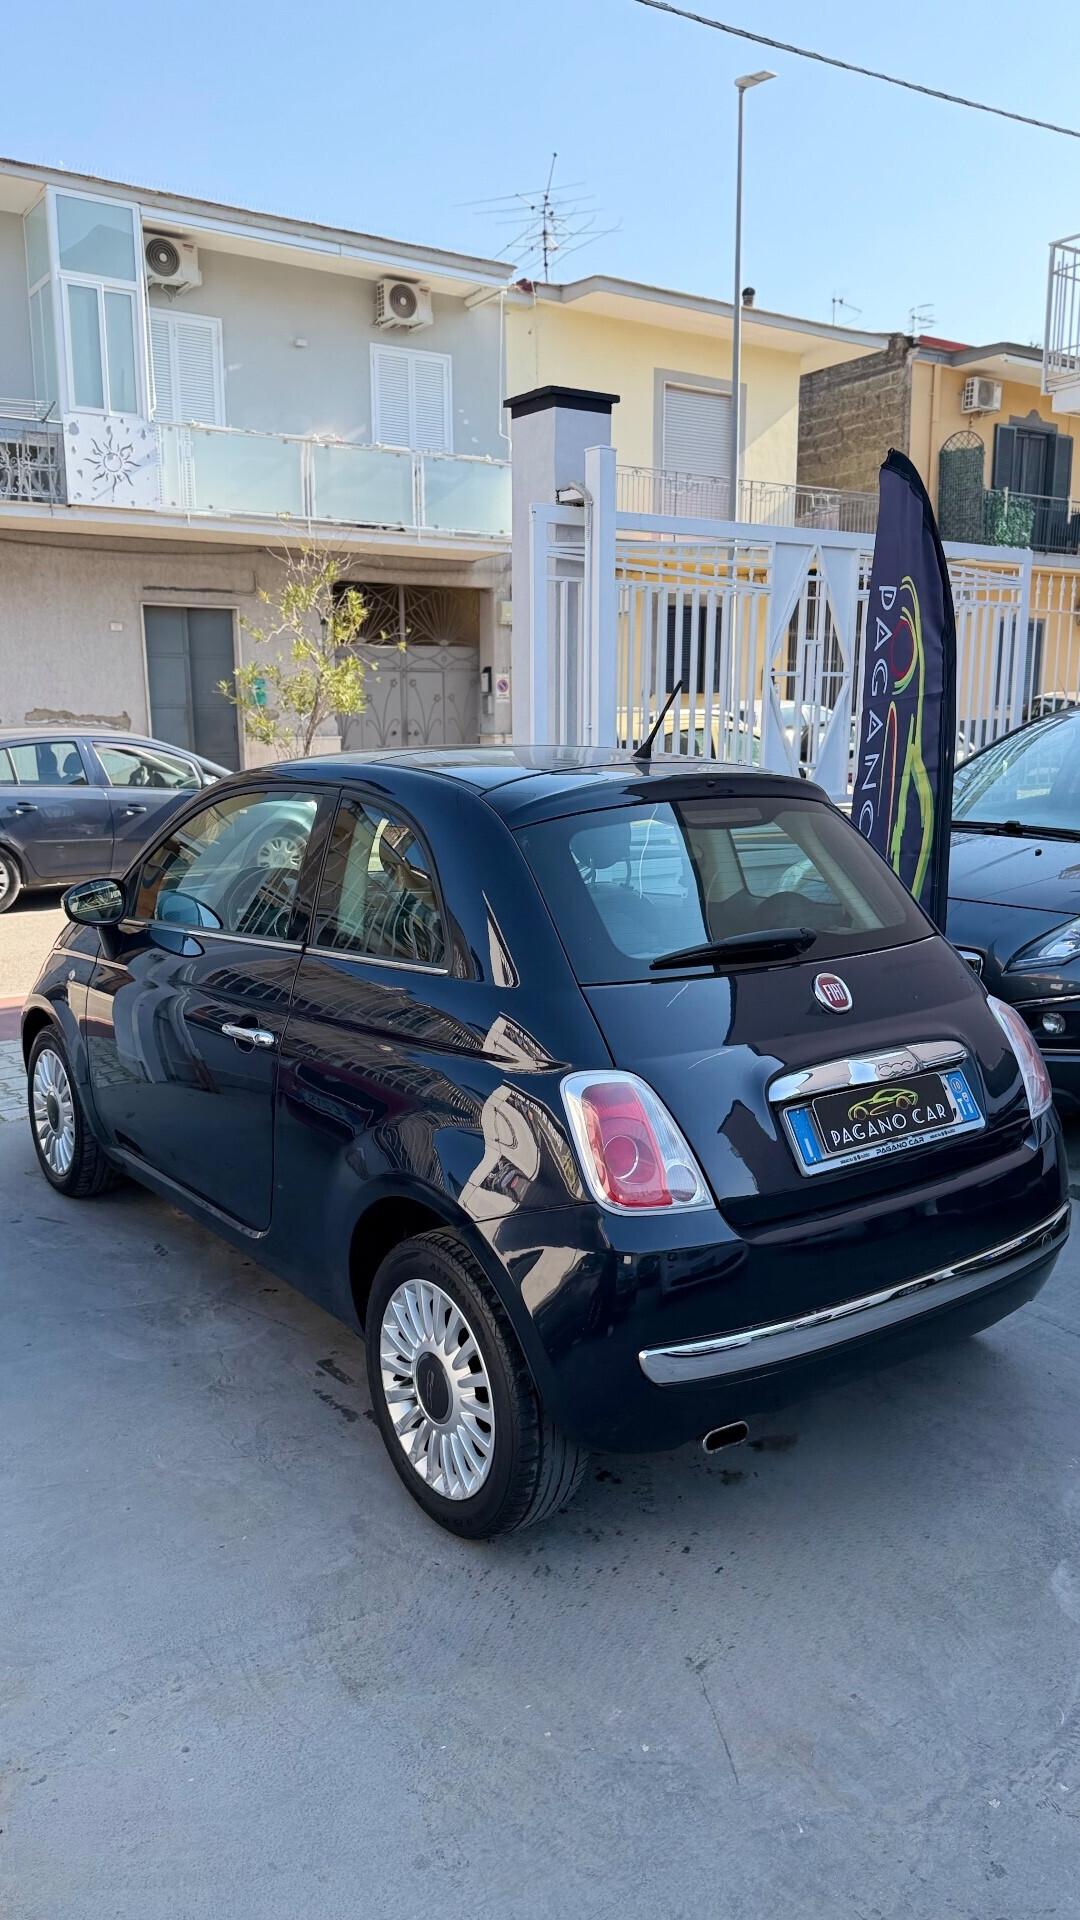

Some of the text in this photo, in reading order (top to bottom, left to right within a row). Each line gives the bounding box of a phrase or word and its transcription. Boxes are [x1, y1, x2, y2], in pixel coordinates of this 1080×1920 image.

[858, 584, 897, 839] PAGANO
[822, 983, 846, 1002] FIAT
[878, 1060, 914, 1077] 500
[830, 1113, 907, 1147] PAGANO
[912, 1103, 947, 1124] CAR
[875, 1136, 925, 1155] PAGANO CAR
